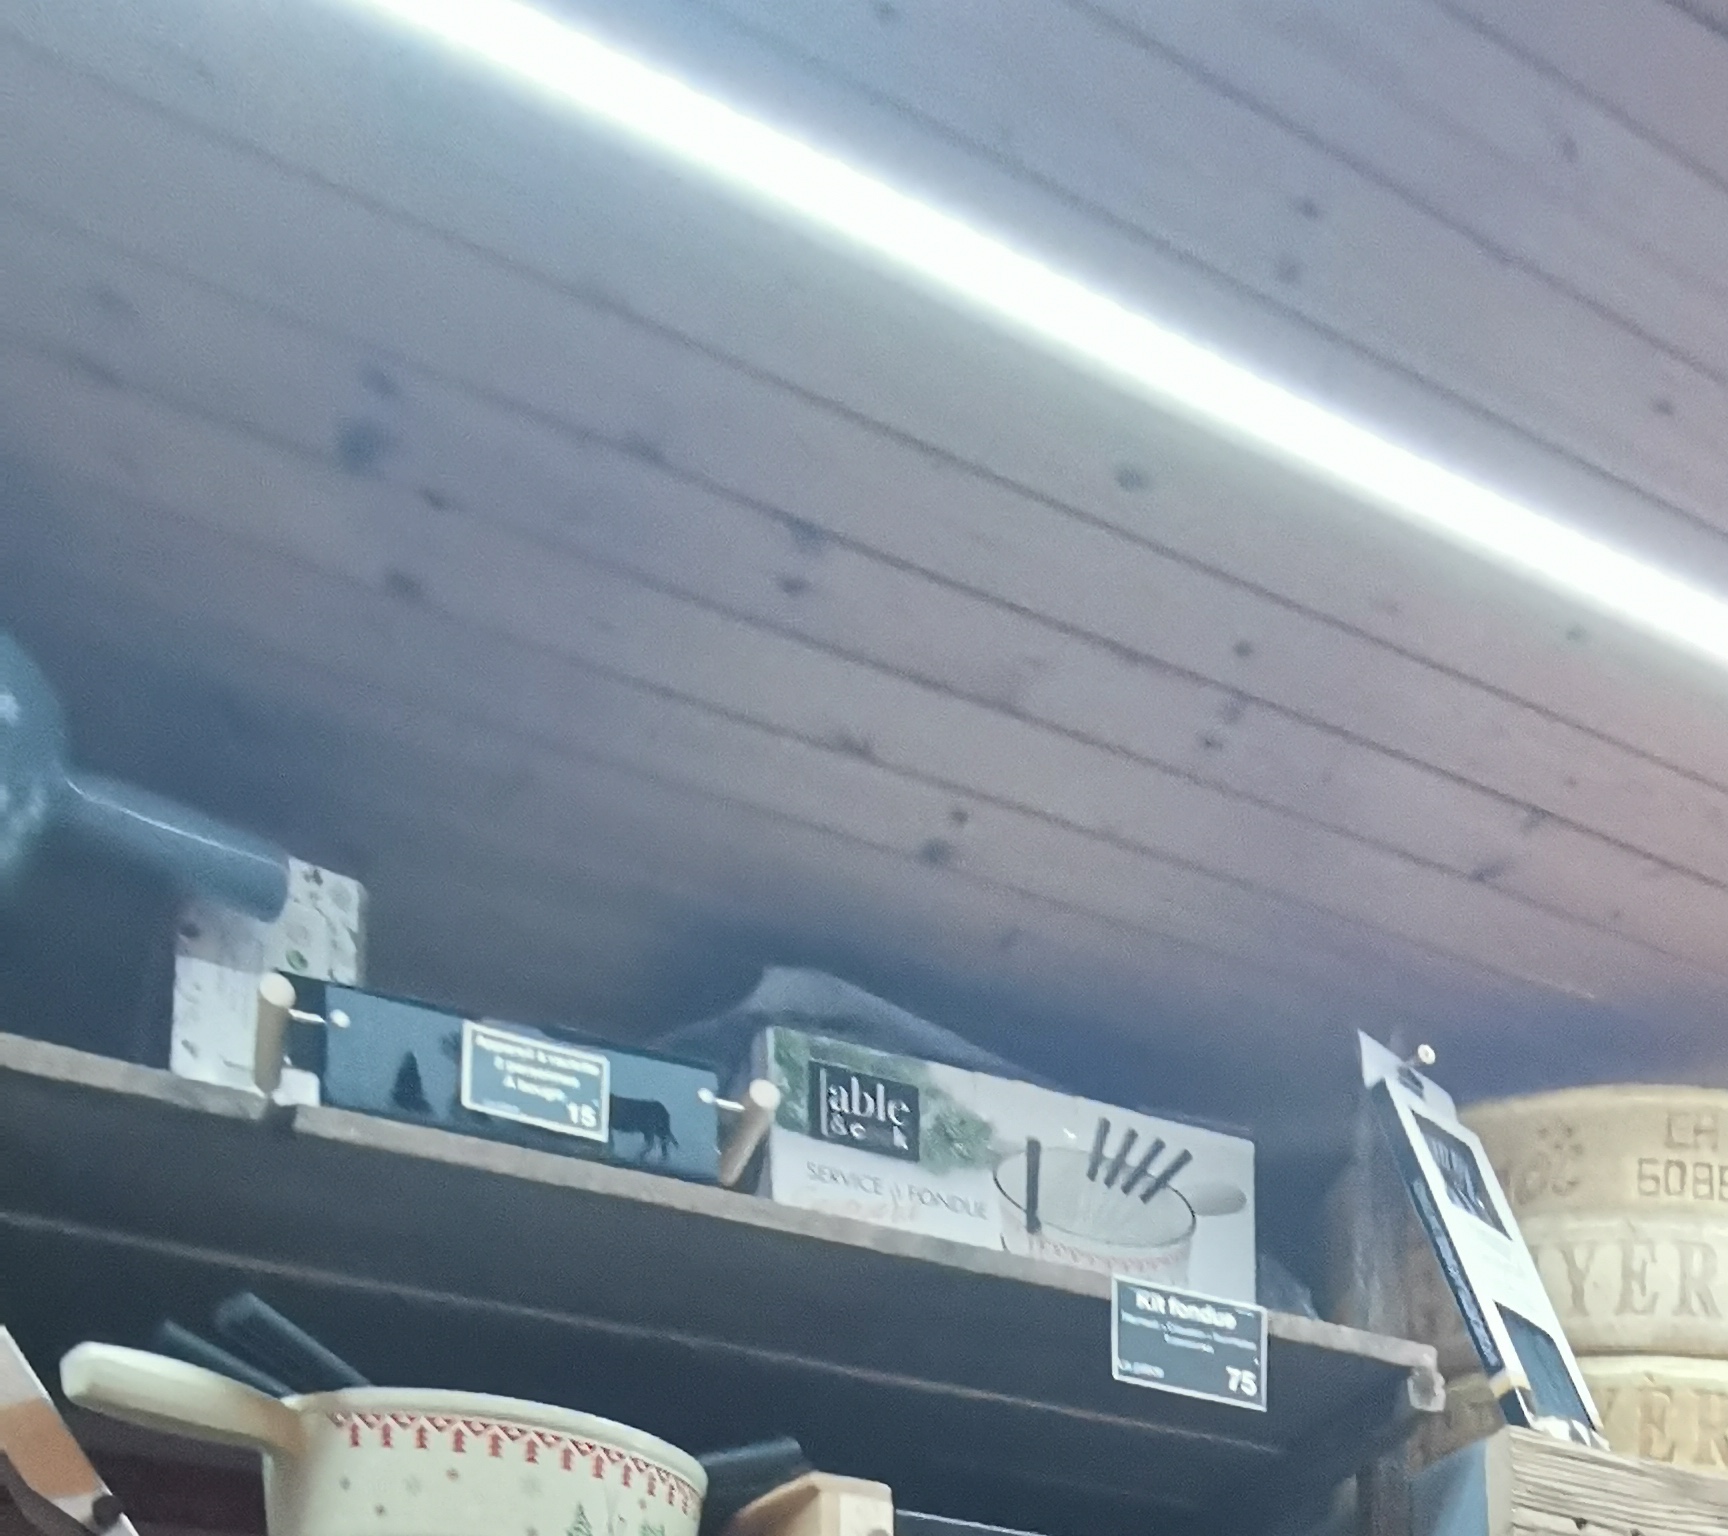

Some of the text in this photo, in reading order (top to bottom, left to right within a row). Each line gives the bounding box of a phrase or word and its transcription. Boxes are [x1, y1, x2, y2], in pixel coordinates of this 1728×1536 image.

[566, 1101, 597, 1128] 15
[806, 1160, 884, 1196] SERVICE
[907, 1184, 988, 1221] FONDUE
[1134, 1287, 1238, 1331] Kit fondue
[1225, 1364, 1258, 1397] 75
